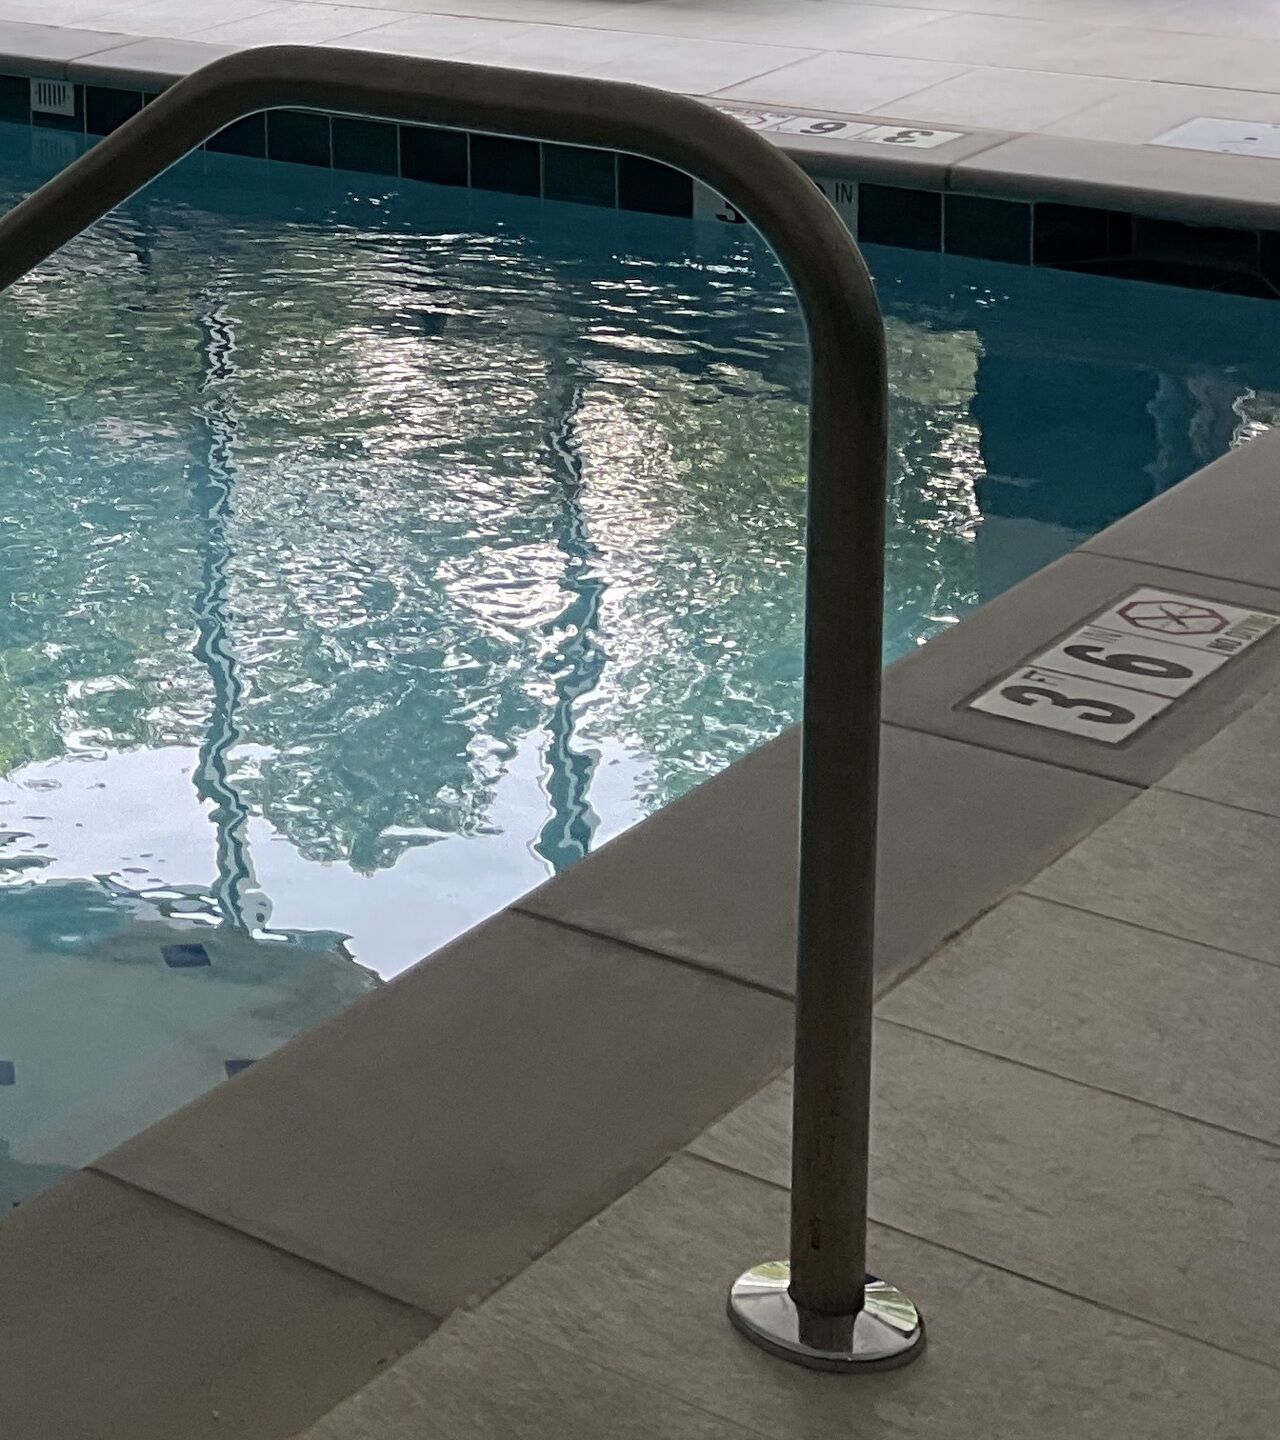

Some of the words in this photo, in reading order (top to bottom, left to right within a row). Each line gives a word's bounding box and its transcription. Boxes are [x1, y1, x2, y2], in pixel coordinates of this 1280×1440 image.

[835, 182, 853, 204] IN
[1064, 645, 1193, 679] 6
[1000, 685, 1136, 725] 3
